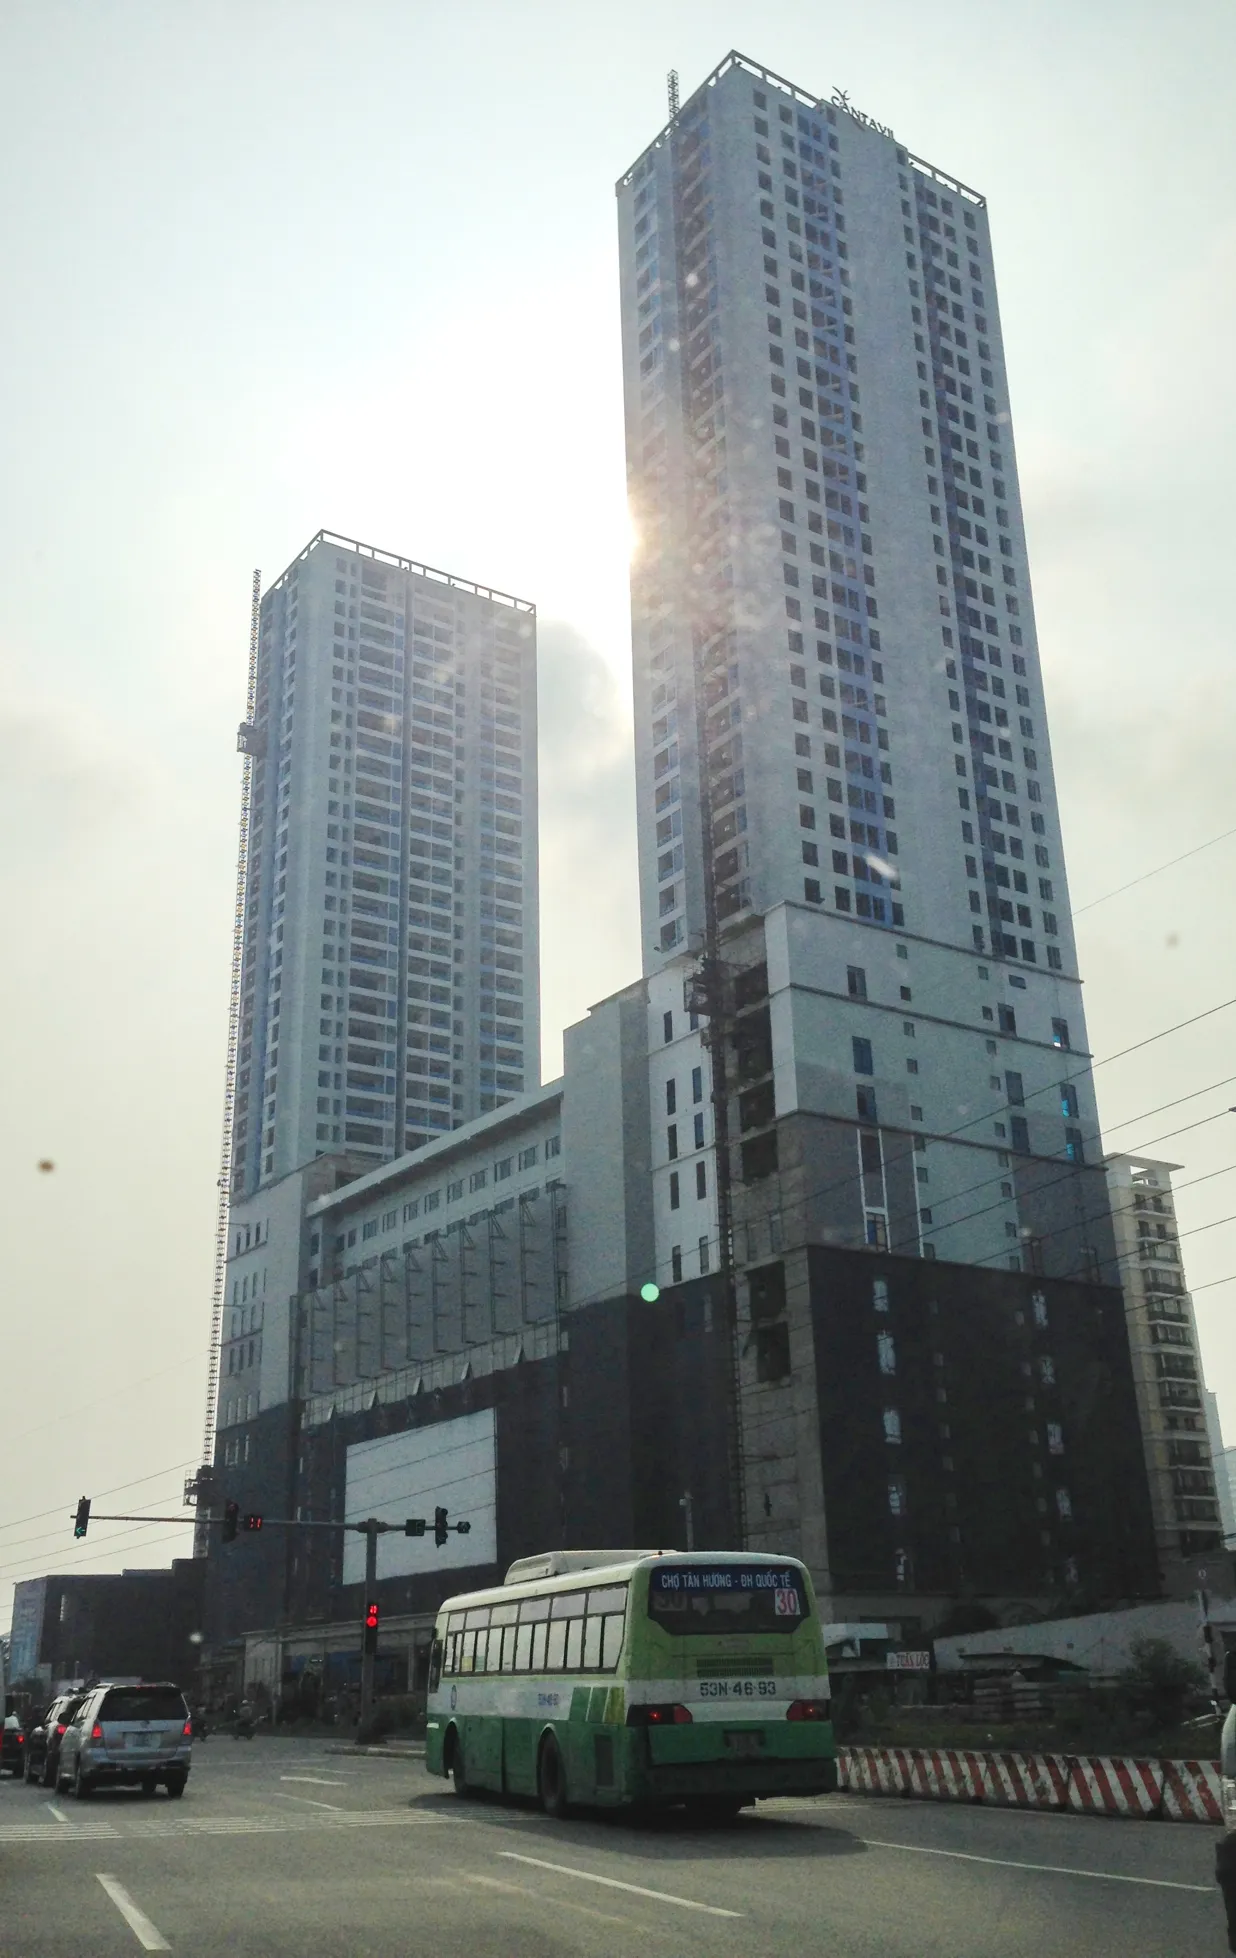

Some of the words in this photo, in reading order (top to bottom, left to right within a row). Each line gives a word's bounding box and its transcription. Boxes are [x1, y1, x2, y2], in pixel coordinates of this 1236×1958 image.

[661, 1573, 680, 1591] CHỢ
[682, 1572, 700, 1588] TÂN
[740, 1574, 754, 1588] ĐH
[755, 1568, 778, 1588] QUỐC
[780, 1569, 792, 1588] TẾ
[776, 1589, 798, 1614] 30
